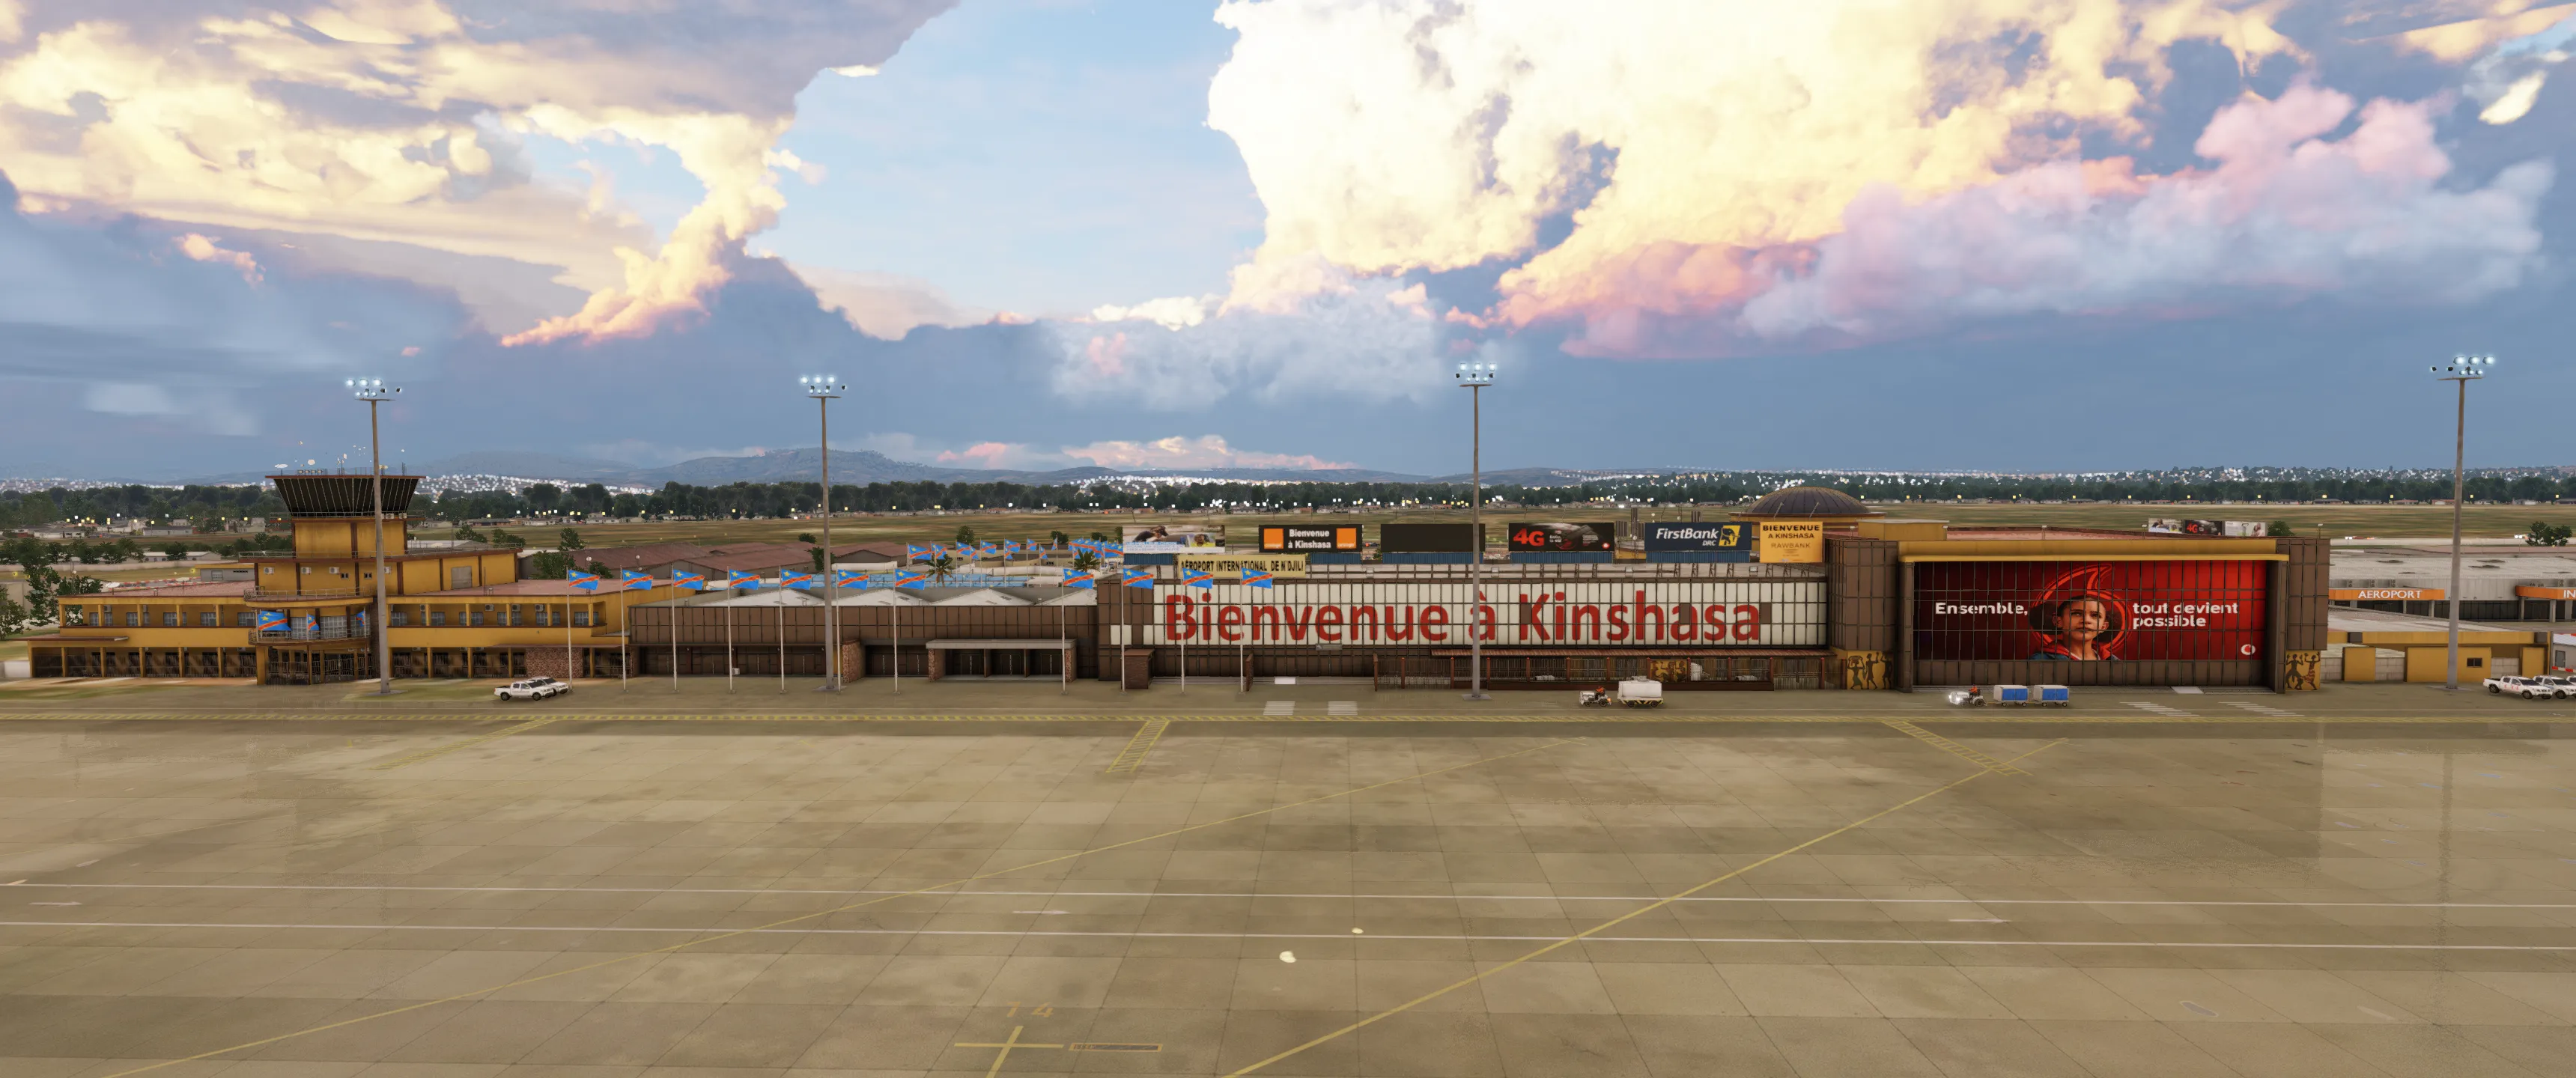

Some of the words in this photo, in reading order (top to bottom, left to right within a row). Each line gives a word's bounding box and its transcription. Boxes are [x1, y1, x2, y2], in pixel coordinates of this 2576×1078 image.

[1289, 529, 1330, 538] Bienvenue
[1513, 528, 1545, 546] 4G
[1656, 528, 1719, 539] FirstBank
[1288, 540, 1293, 549] à
[1295, 540, 1331, 549] Kinshasa
[1216, 560, 1267, 572] INTERNATIONAL
[1271, 561, 1280, 572] DE
[2358, 590, 2422, 599] AEROPORT
[1935, 602, 2029, 616] Ensemble,
[2133, 602, 2169, 615] tout
[2173, 602, 2239, 615] devient
[1165, 593, 1448, 642] Bienvenue
[1468, 591, 1495, 642] à
[1519, 591, 1759, 642] Kinshasa
[2133, 615, 2207, 630] possible
